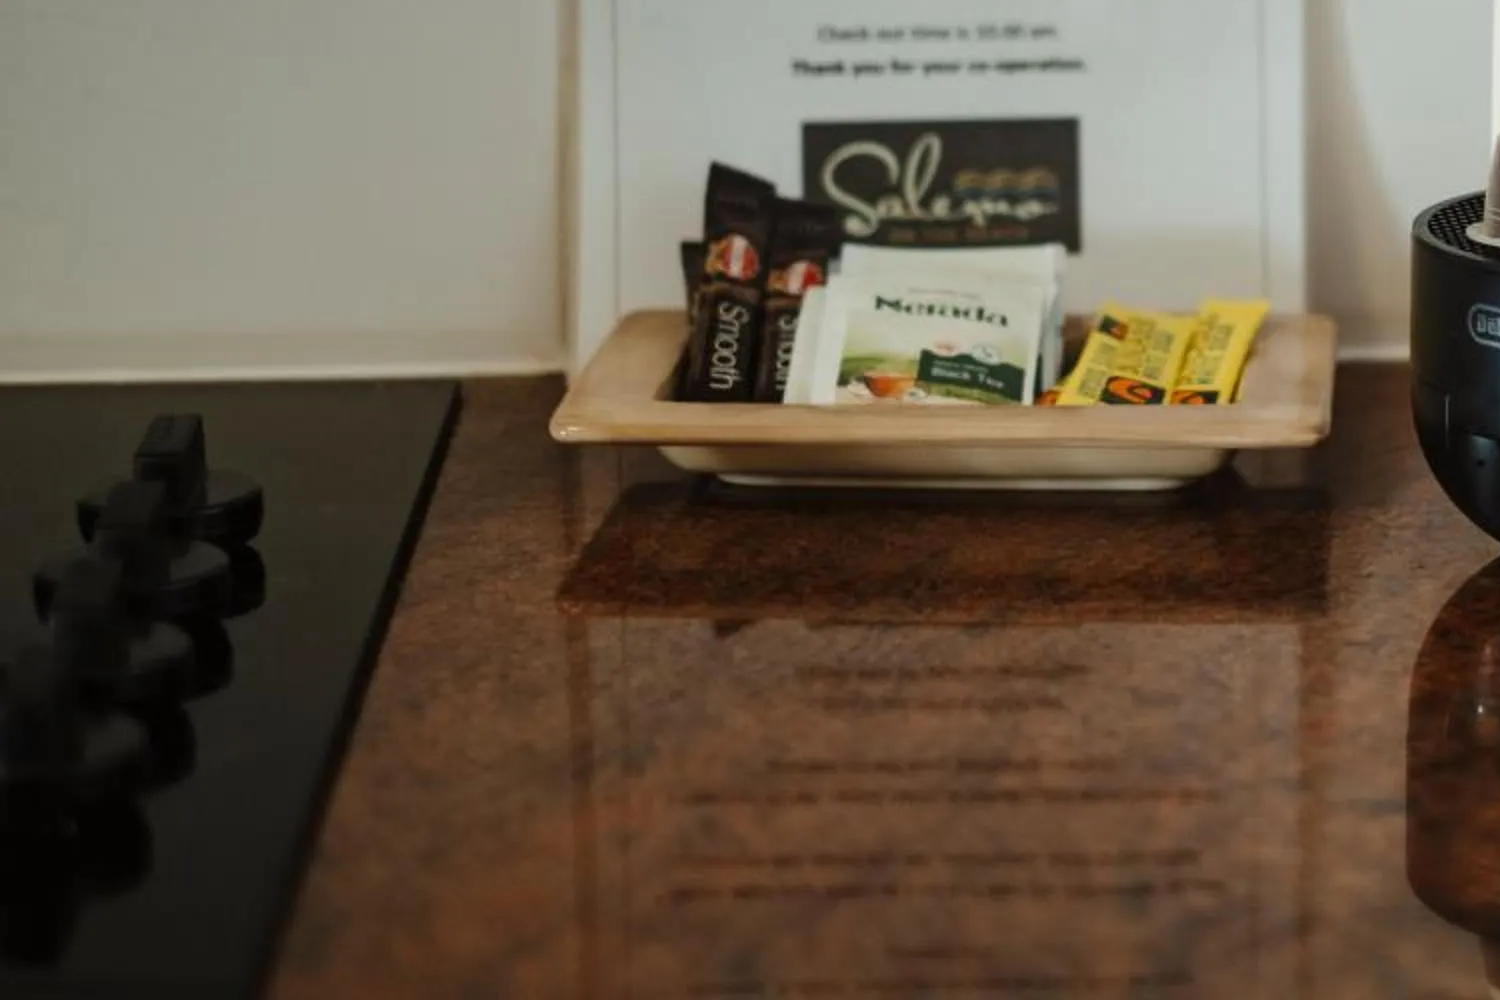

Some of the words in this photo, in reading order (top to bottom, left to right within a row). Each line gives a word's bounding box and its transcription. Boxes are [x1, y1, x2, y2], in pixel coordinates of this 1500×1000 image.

[791, 60, 847, 77] Thank
[709, 301, 750, 390] Smooth
[930, 366, 973, 382] Black
